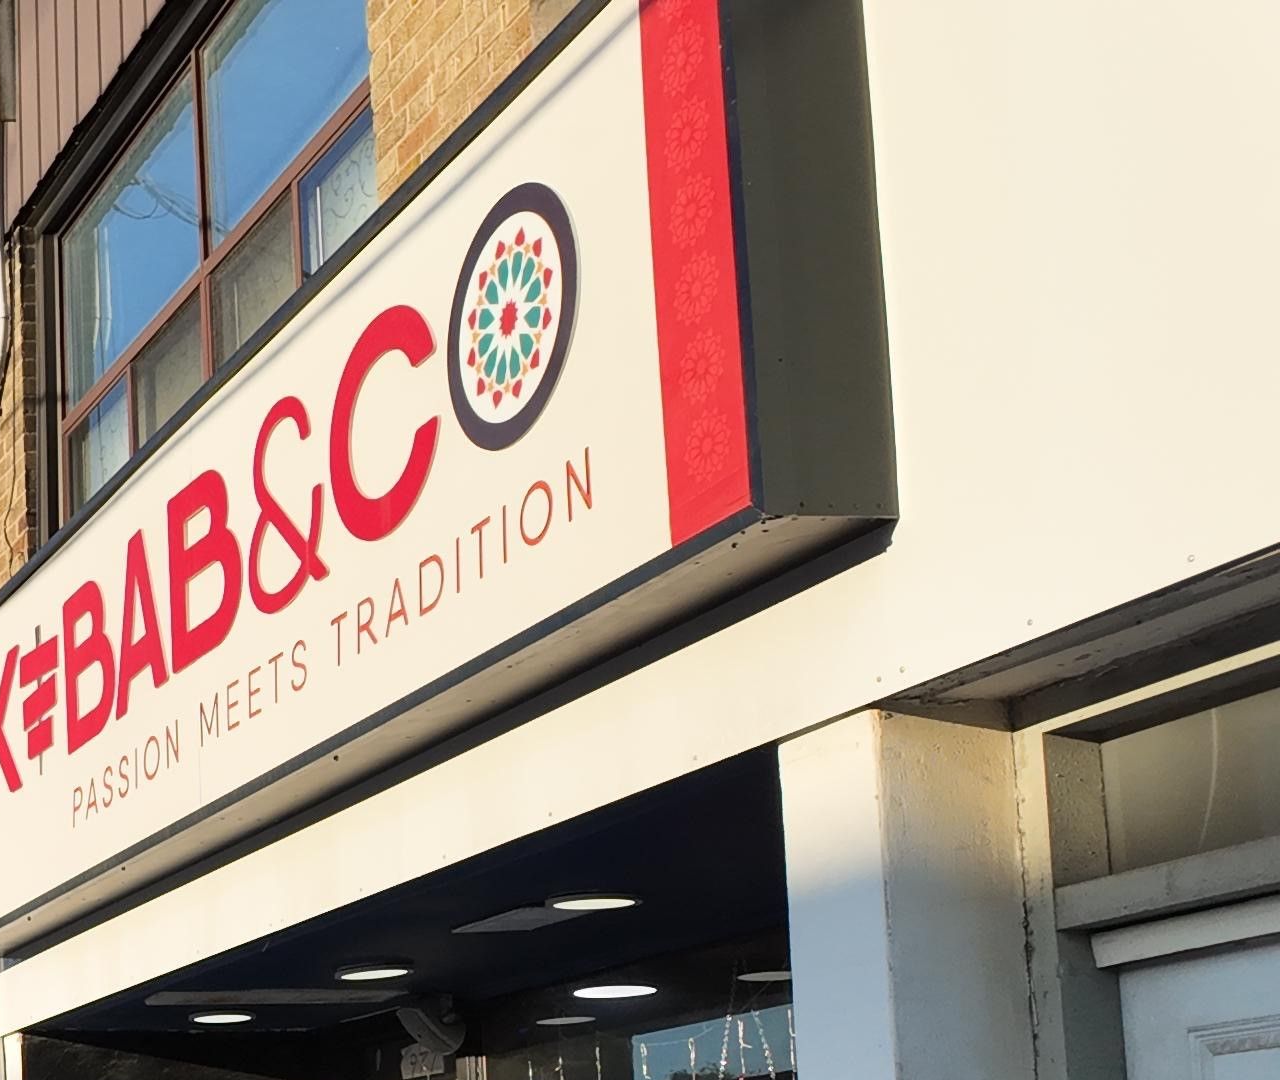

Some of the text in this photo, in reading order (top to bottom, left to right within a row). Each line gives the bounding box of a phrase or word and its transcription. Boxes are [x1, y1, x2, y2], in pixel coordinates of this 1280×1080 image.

[71, 446, 593, 828] PASSION MEETS TRADITION
